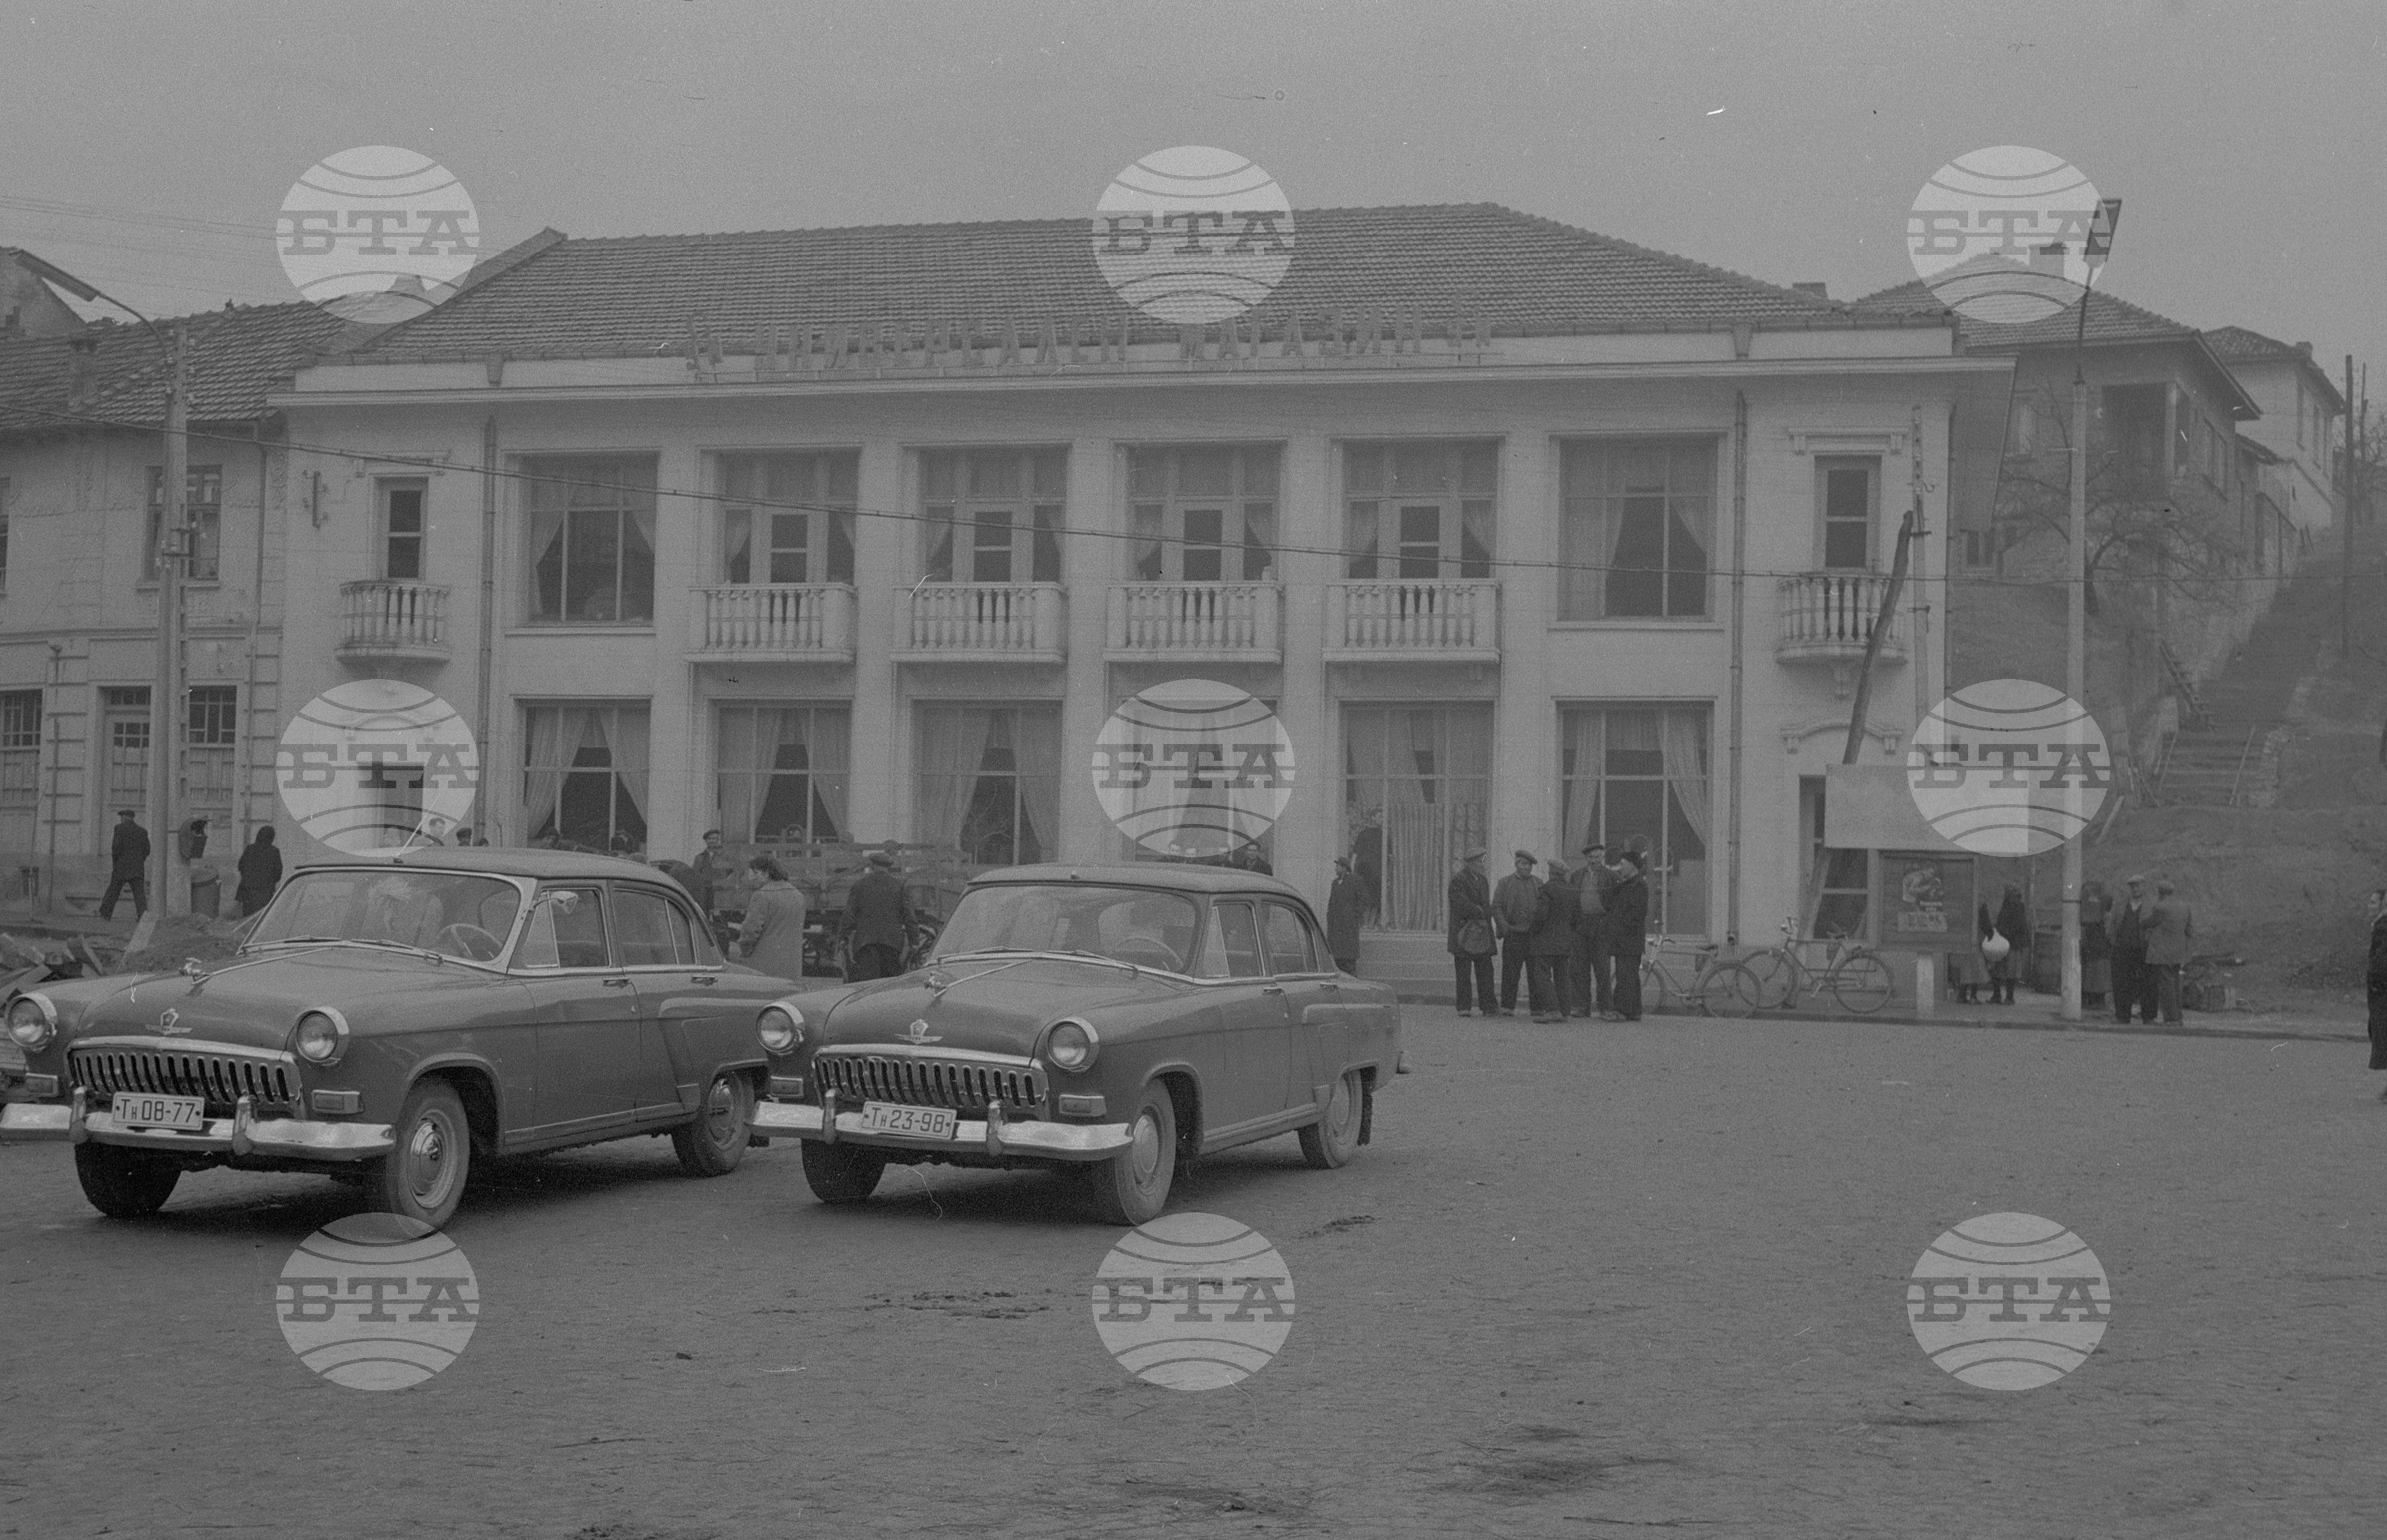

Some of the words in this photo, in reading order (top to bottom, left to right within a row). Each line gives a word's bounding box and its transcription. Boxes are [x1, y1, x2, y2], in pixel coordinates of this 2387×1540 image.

[1180, 304, 1421, 359] МАГАЗИН
[141, 1100, 195, 1122] 08-77
[890, 1109, 945, 1132] 23-98
